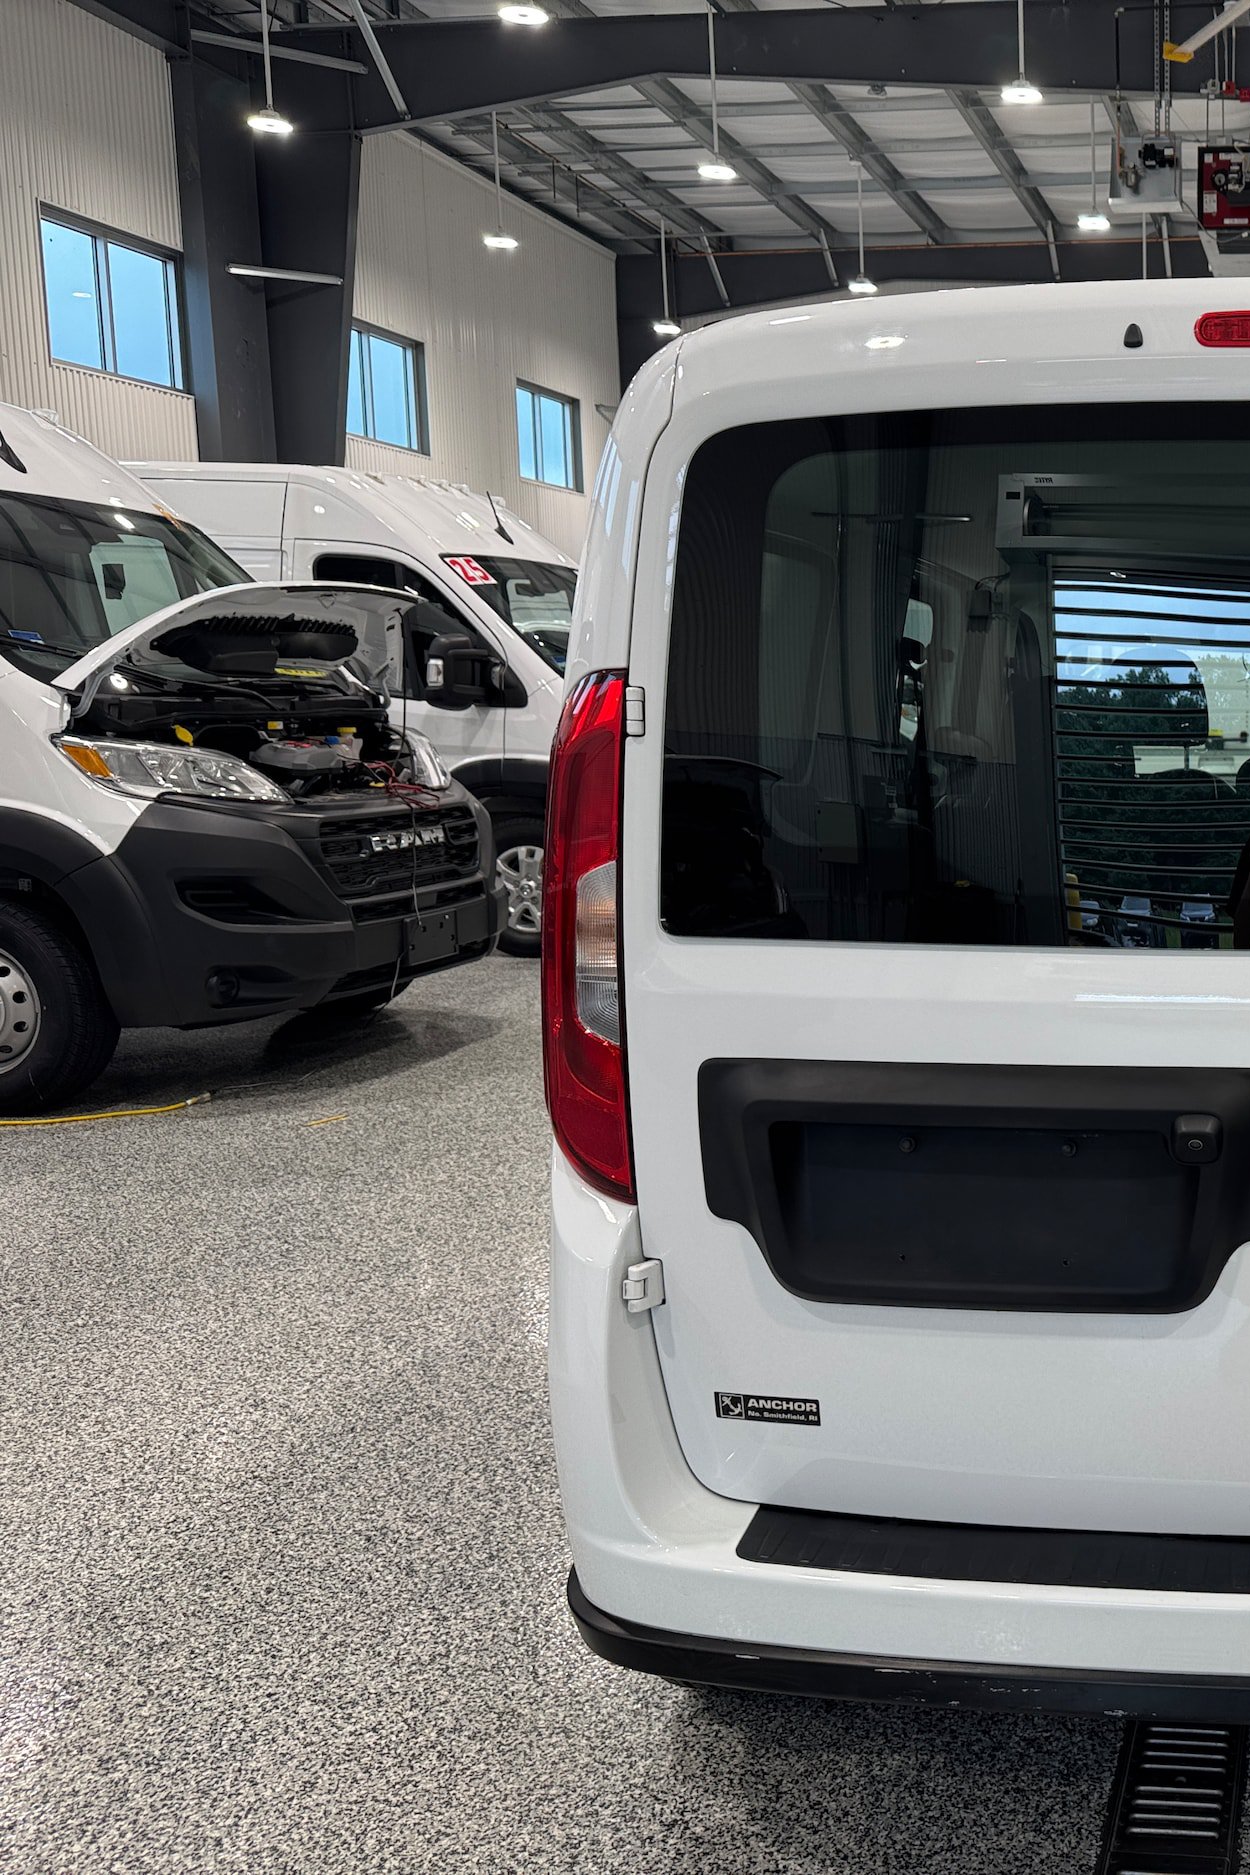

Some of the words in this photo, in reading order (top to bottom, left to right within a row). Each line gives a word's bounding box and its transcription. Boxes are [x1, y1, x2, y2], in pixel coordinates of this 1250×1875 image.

[449, 559, 490, 581] 25
[370, 827, 446, 852] RAM
[747, 1398, 818, 1413] ANCHOR
[763, 1411, 807, 1421] Smithfield,
